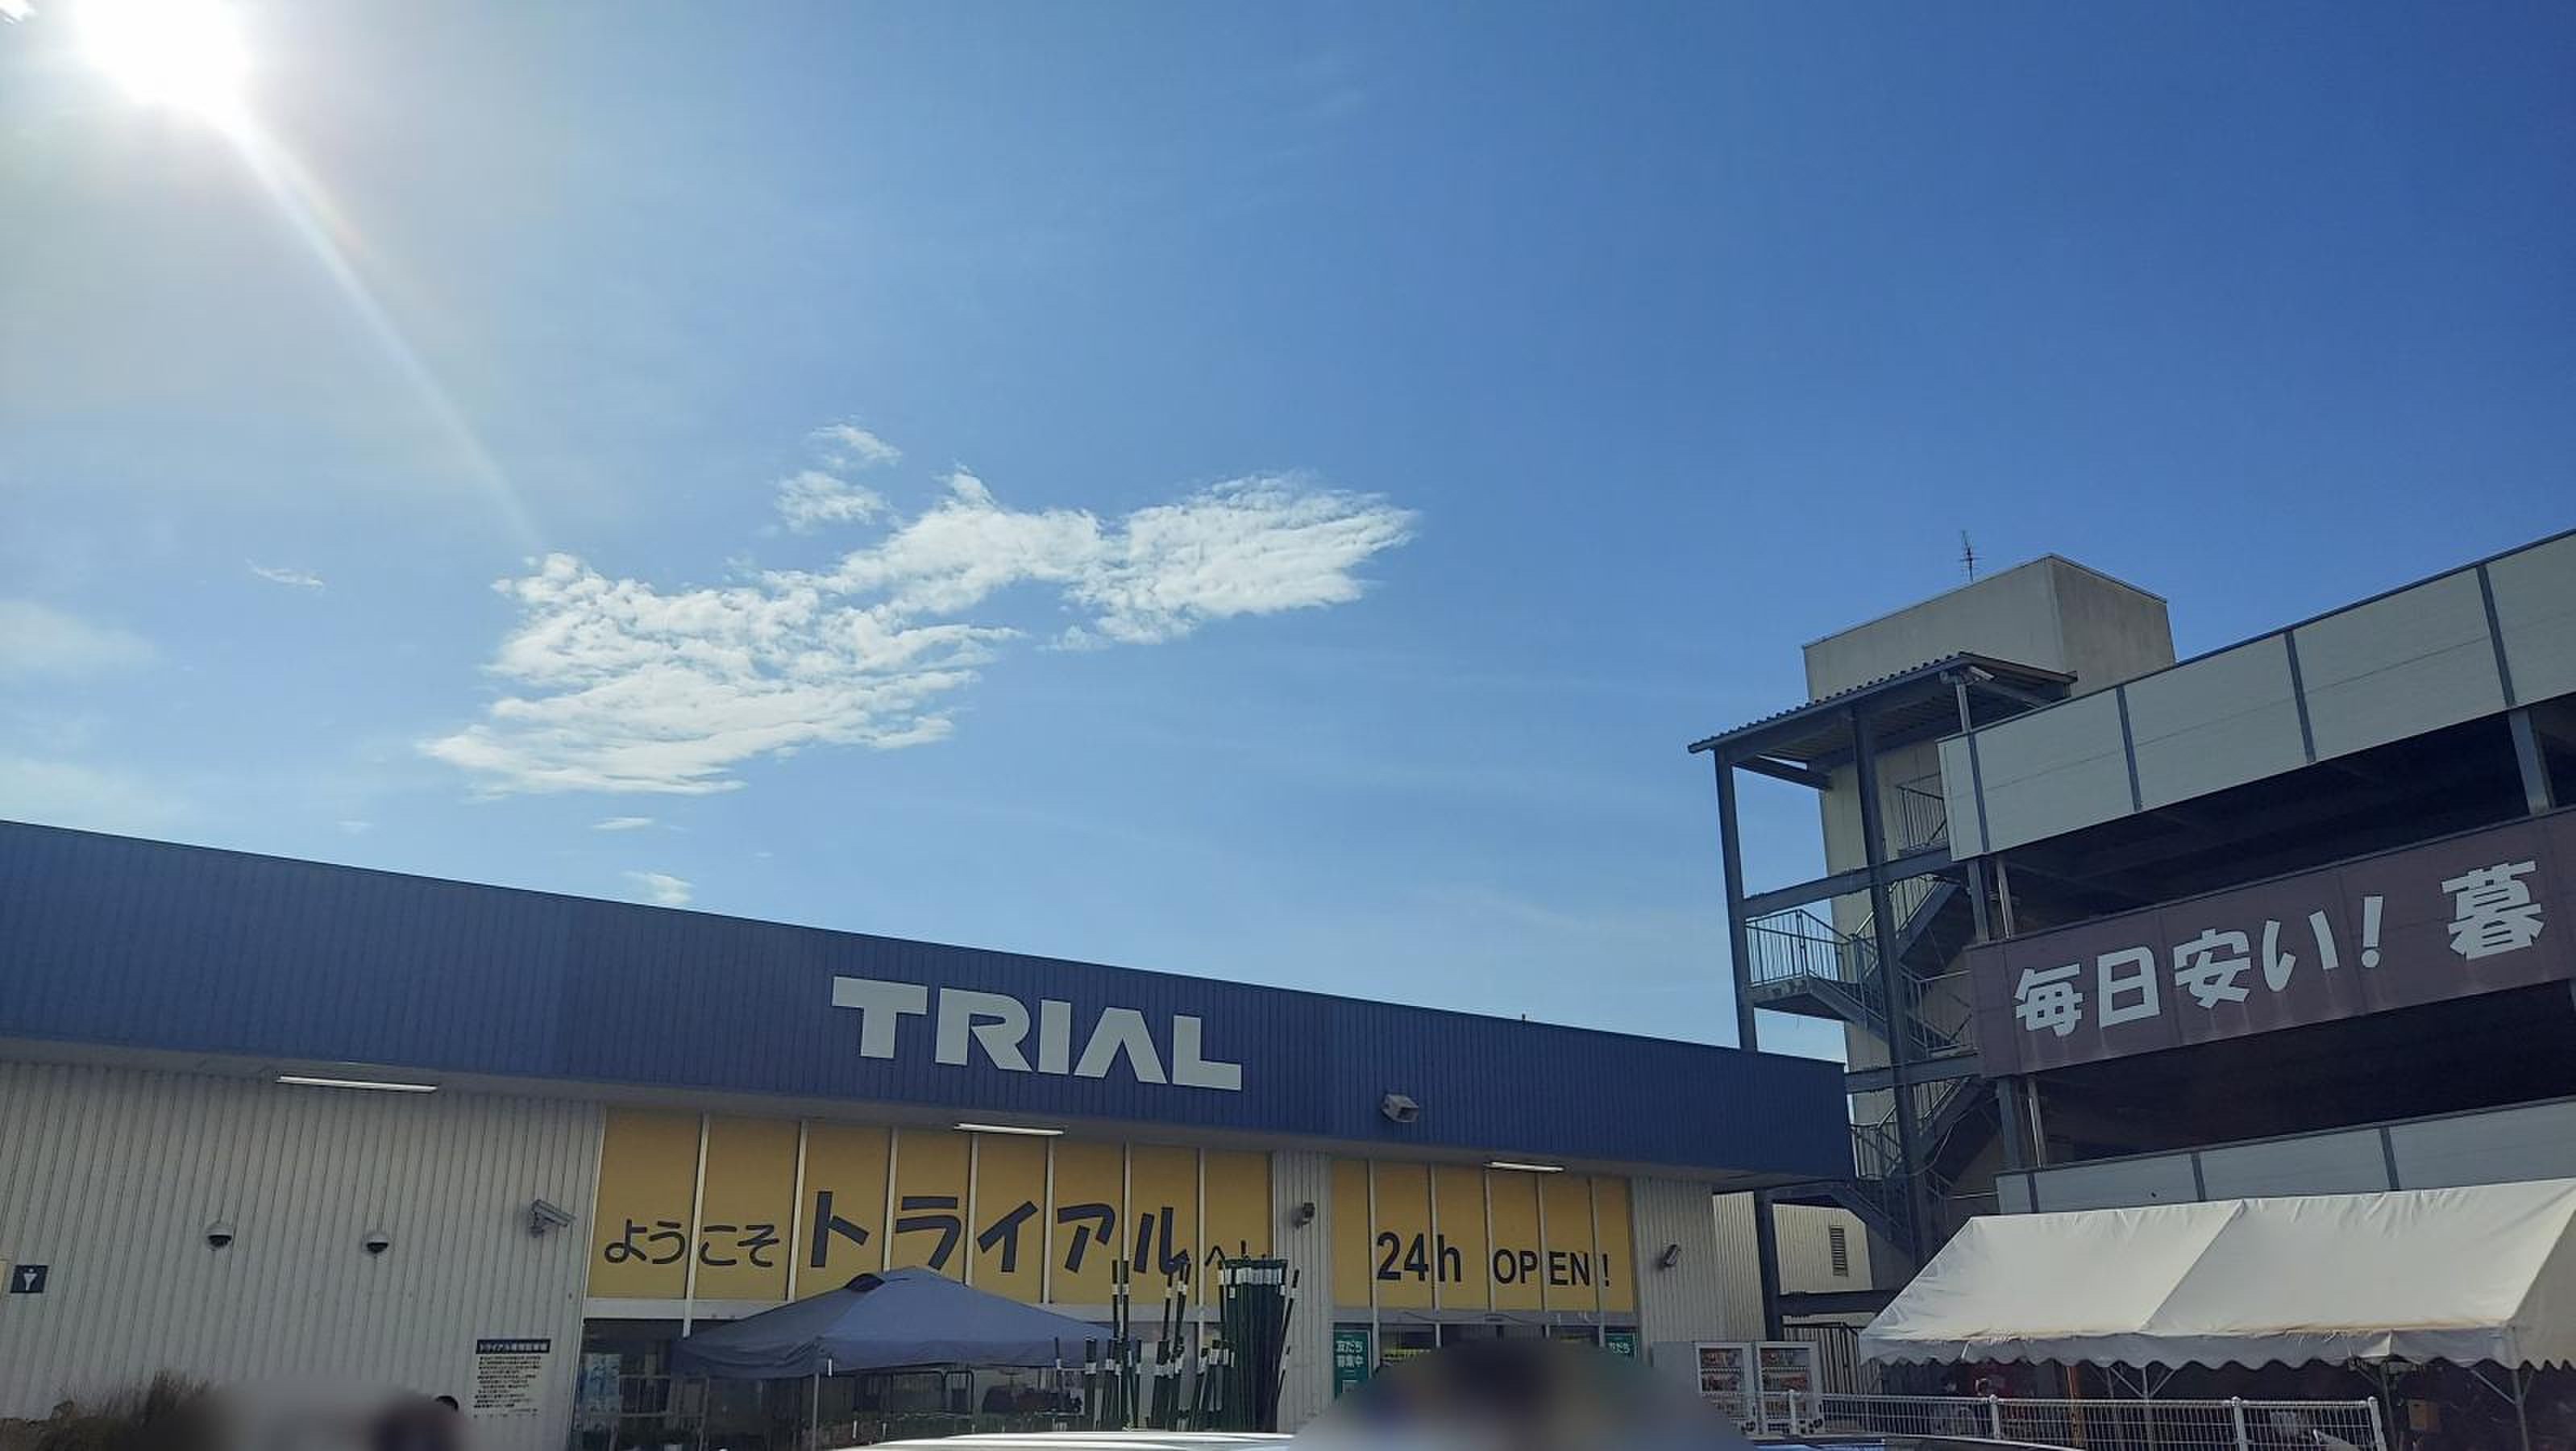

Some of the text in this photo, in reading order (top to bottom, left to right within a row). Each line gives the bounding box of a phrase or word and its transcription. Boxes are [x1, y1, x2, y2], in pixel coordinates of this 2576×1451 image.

[2441, 860, 2545, 961] 暮
[831, 975, 1243, 1091] TRIAL
[1376, 1231, 1461, 1283] 24h
